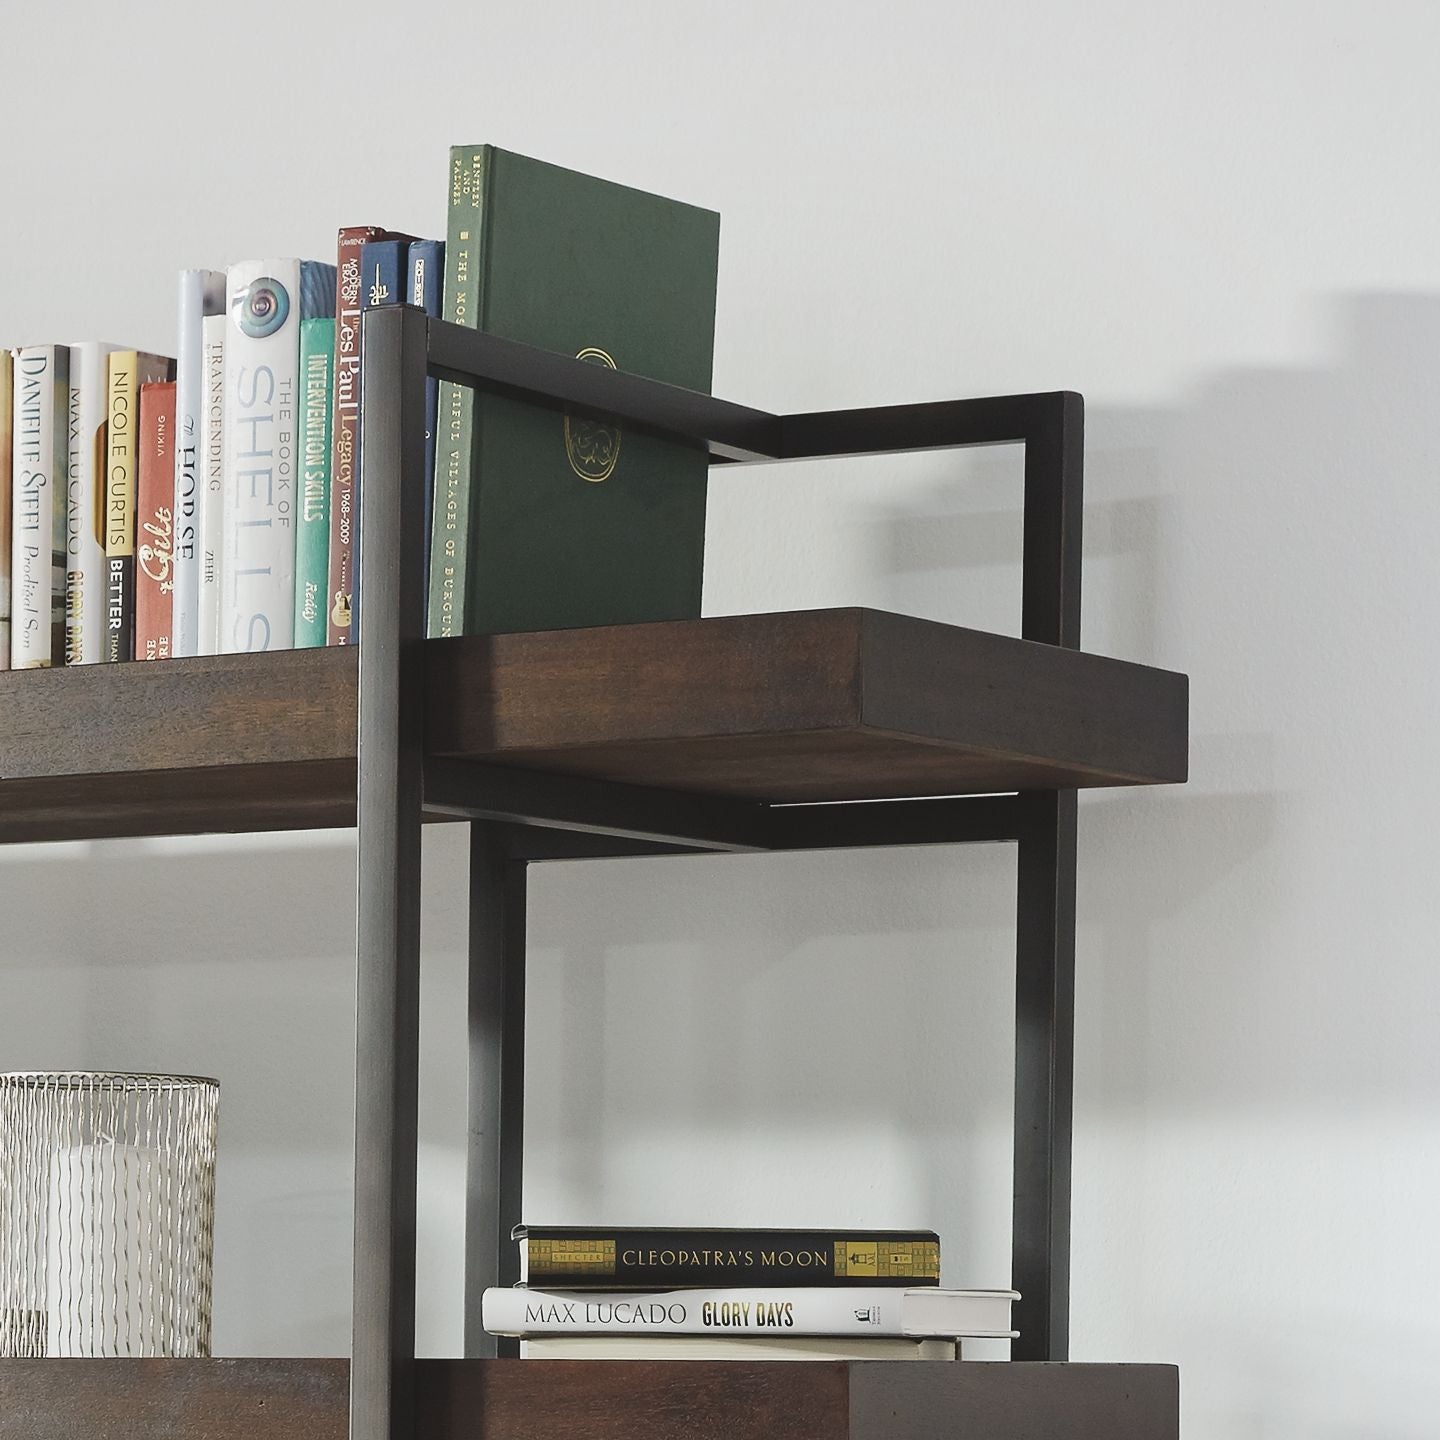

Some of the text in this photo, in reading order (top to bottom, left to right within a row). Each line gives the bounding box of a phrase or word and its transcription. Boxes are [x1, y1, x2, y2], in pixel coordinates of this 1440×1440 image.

[462, 169, 471, 194] AND
[471, 154, 481, 208] BENTLEY
[341, 263, 349, 301] ERA OF
[349, 258, 358, 306] MODERN
[457, 250, 468, 282] THE
[340, 309, 360, 353] Les
[456, 291, 466, 324] MOS
[338, 355, 360, 410] Paul
[157, 415, 166, 457] VIKING
[210, 341, 223, 491] TRANSCENDING
[303, 354, 328, 523] INTERVENTION SKILLS
[68, 387, 84, 555] MAX LUCADO
[109, 371, 128, 546] NICOLE CURTIS
[277, 378, 292, 528] THE BOOK OF
[336, 415, 358, 486] Legacy
[234, 364, 275, 651] SHELLS
[446, 450, 460, 530] VILLAGES
[204, 549, 214, 584] ZEHR
[445, 538, 456, 557] OF
[23, 544, 39, 649] Prodigal Son
[66, 570, 84, 619] GLORY
[109, 559, 124, 662] BETTER THAN
[302, 581, 318, 624] Reddy
[441, 566, 454, 638] BURGUN
[553, 1253, 602, 1262] SHECTER
[622, 1249, 828, 1267] CLEOPATRA'S MOON
[525, 1302, 687, 1325] MAX LUCADO
[702, 1301, 795, 1328] GLORY DAYS
